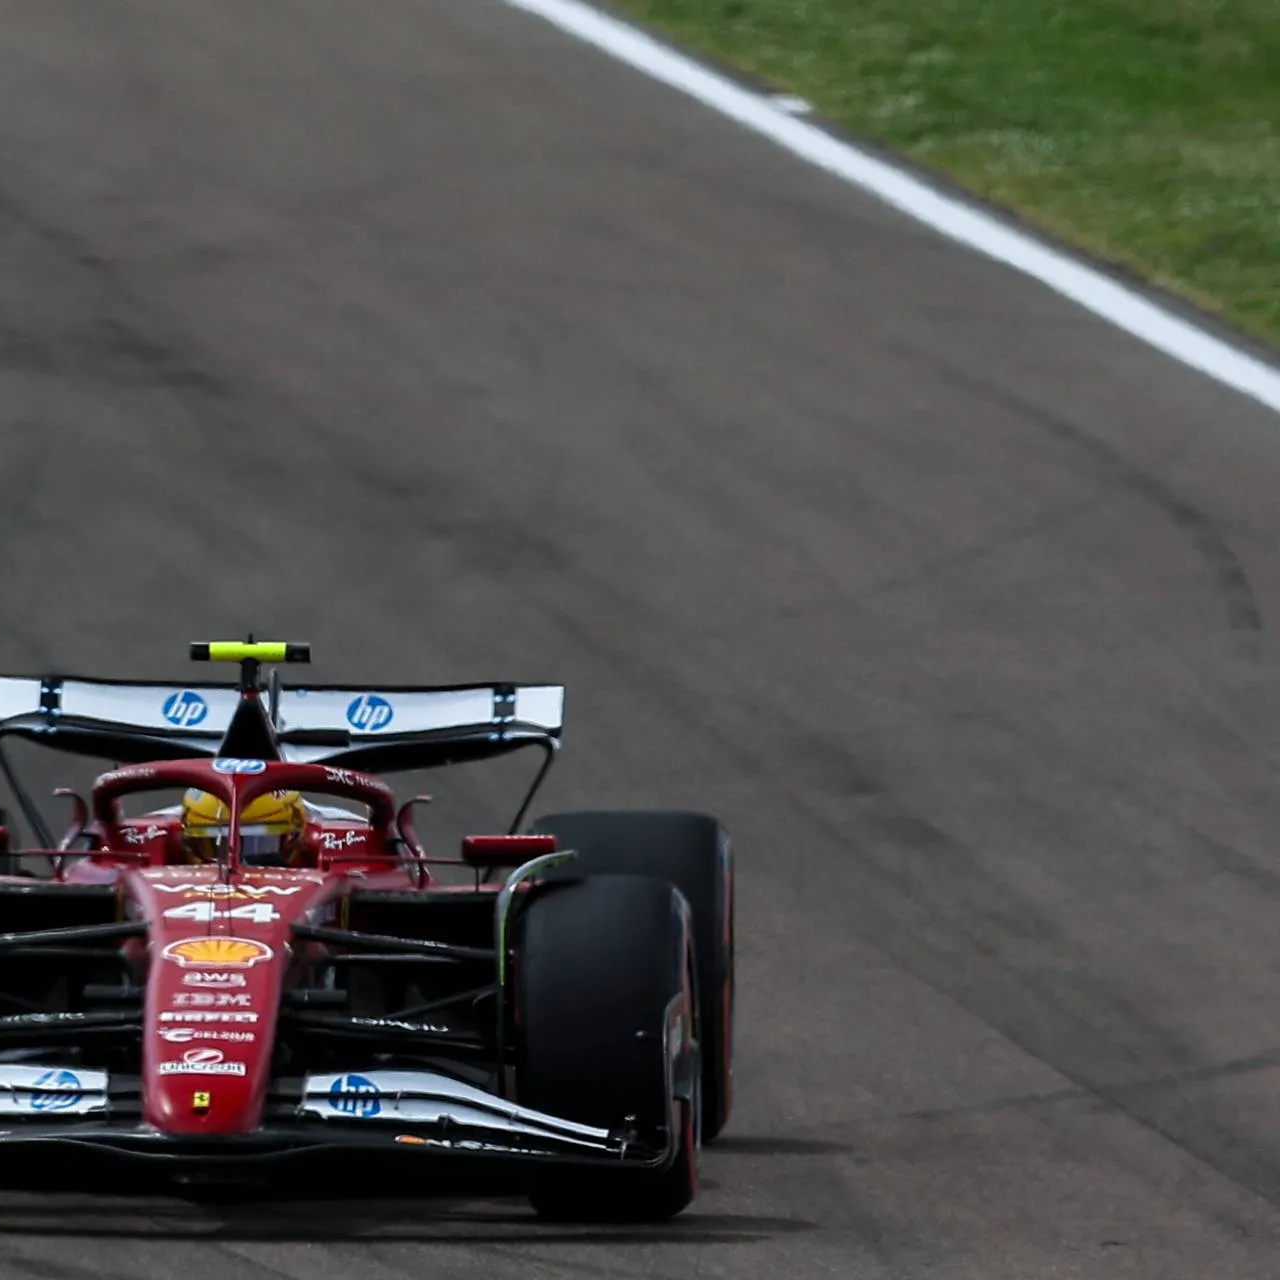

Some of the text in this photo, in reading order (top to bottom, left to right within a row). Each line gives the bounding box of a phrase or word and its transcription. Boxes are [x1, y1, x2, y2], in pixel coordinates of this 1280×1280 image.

[165, 691, 205, 727] hp
[349, 694, 390, 731] hp
[320, 830, 366, 850] Ray-Ban
[162, 901, 281, 923] 44
